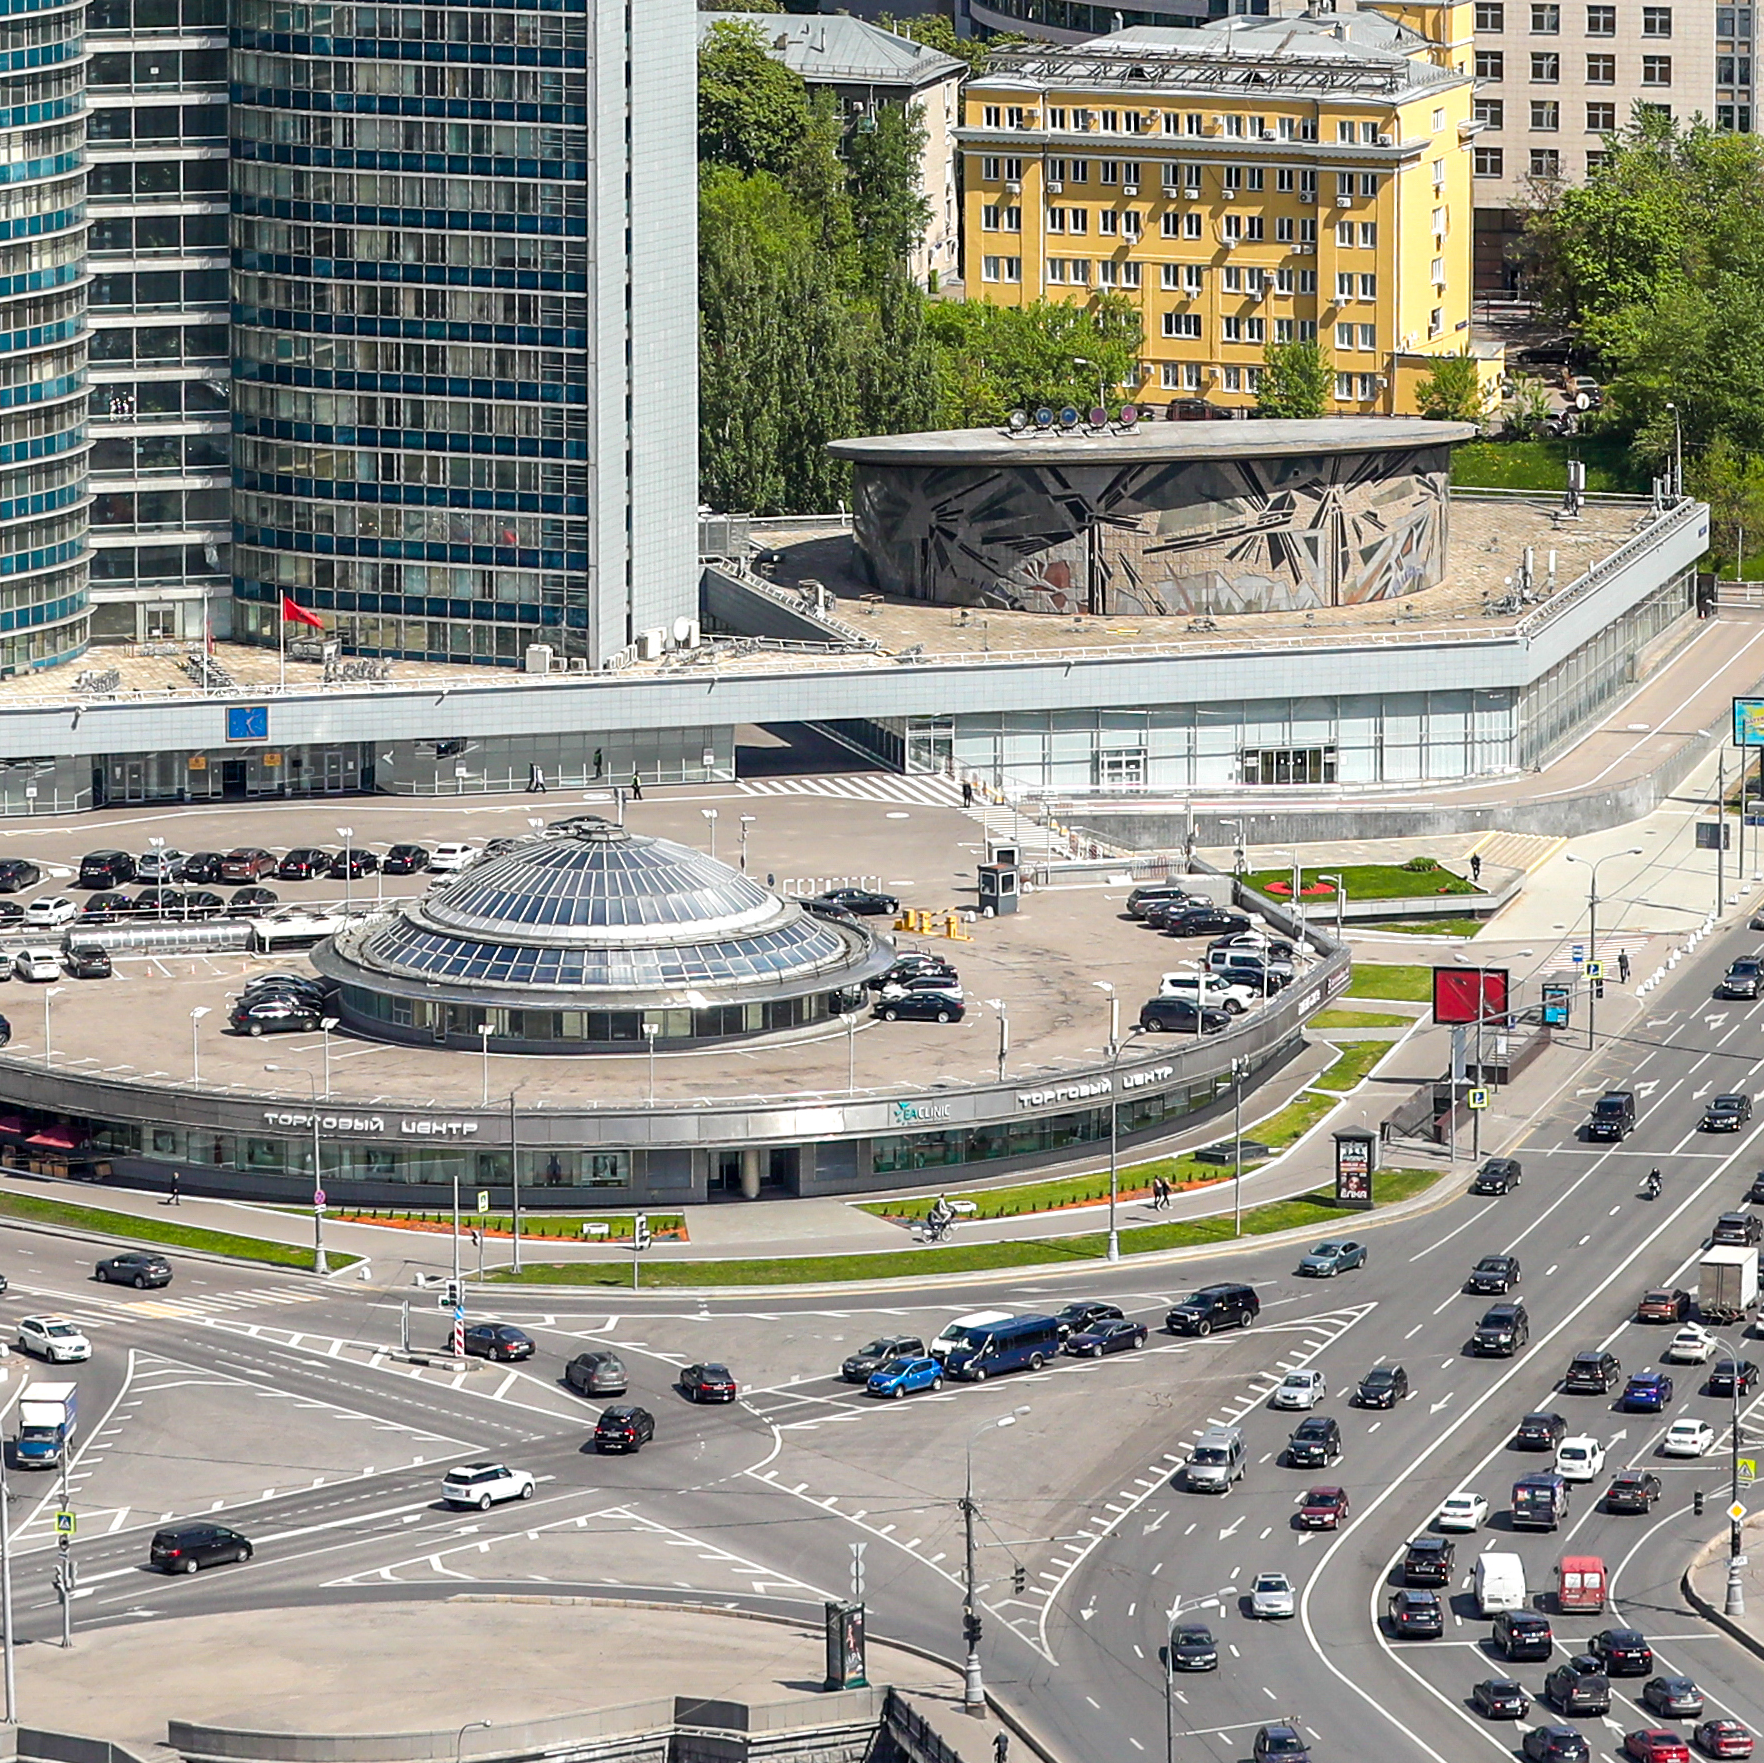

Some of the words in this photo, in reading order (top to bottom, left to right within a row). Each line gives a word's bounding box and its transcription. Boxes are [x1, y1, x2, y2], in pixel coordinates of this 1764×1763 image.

[1019, 1077, 1112, 1107] ТОРГОВЫЙ
[1123, 1066, 1174, 1088] ЦЕНТР
[264, 1112, 384, 1132] ТОРГОВЫЙ
[401, 1120, 478, 1135] ЦЕНТР
